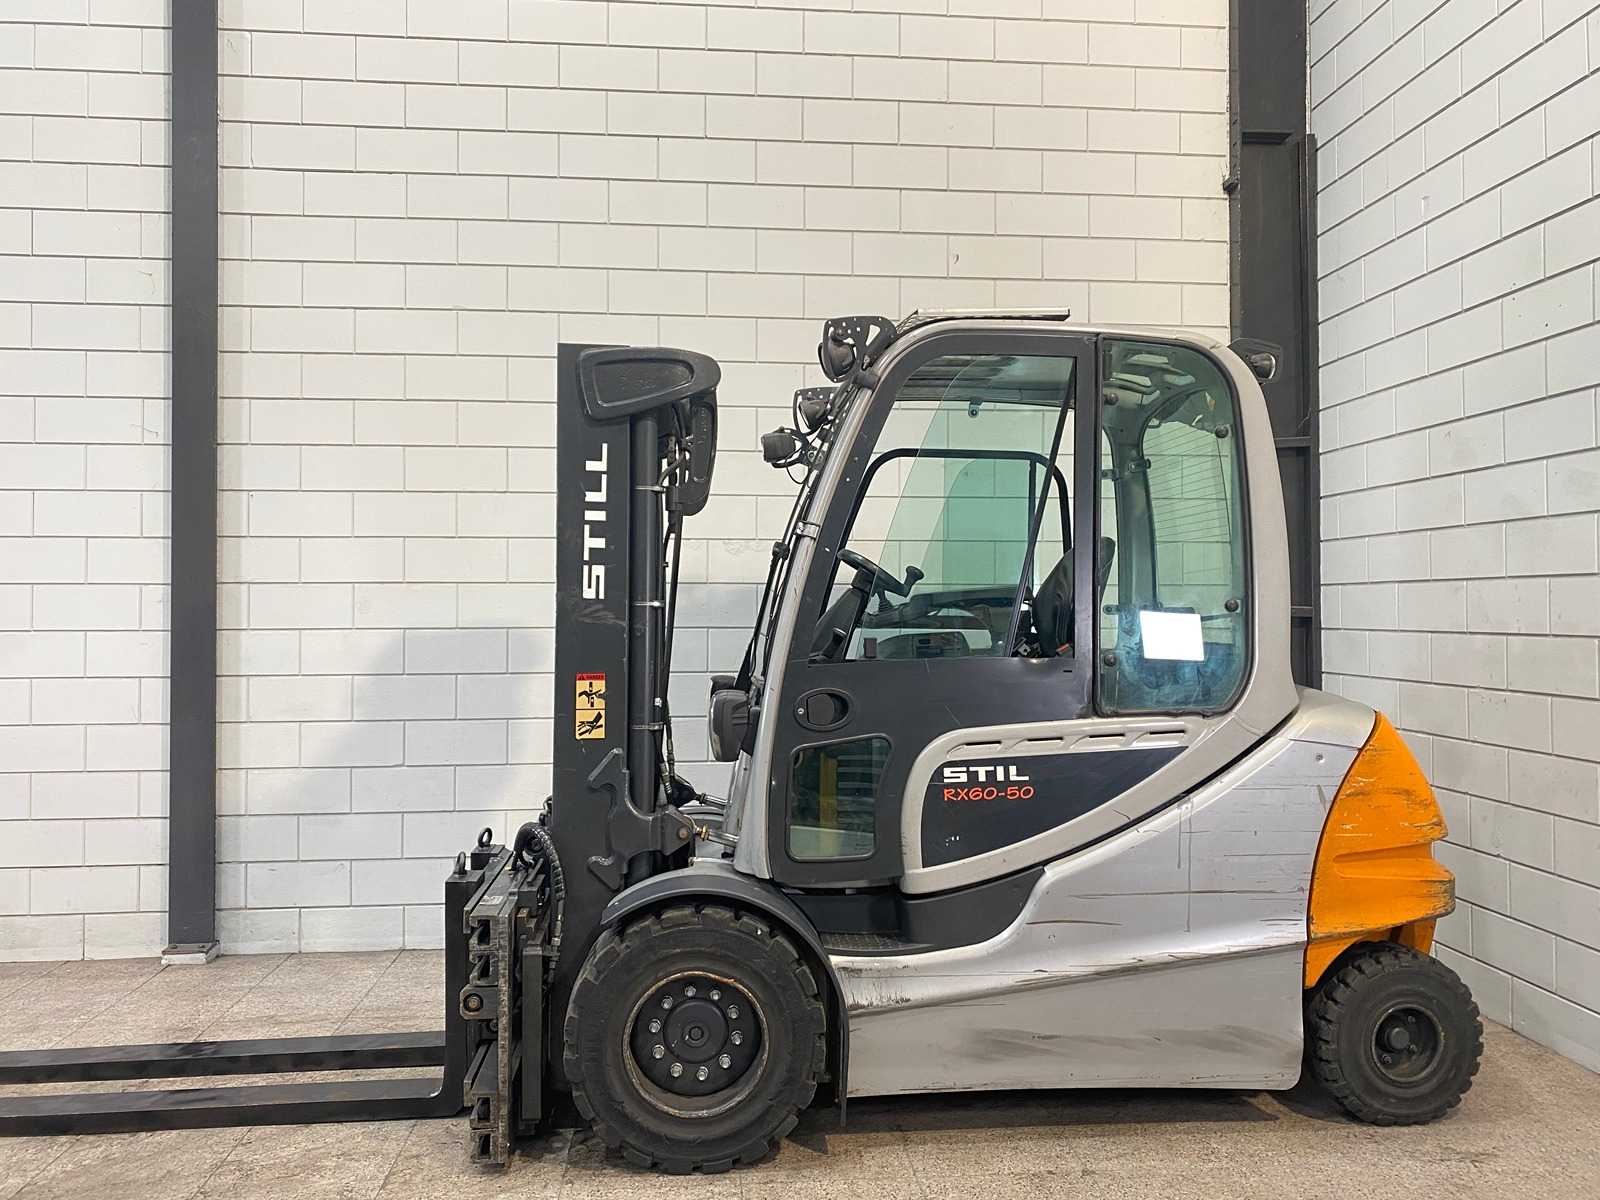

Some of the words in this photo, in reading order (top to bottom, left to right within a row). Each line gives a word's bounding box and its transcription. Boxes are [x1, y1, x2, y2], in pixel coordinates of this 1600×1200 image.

[583, 443, 608, 600] STILL
[943, 765, 1030, 783] STIL
[943, 786, 1035, 801] RX60-50
